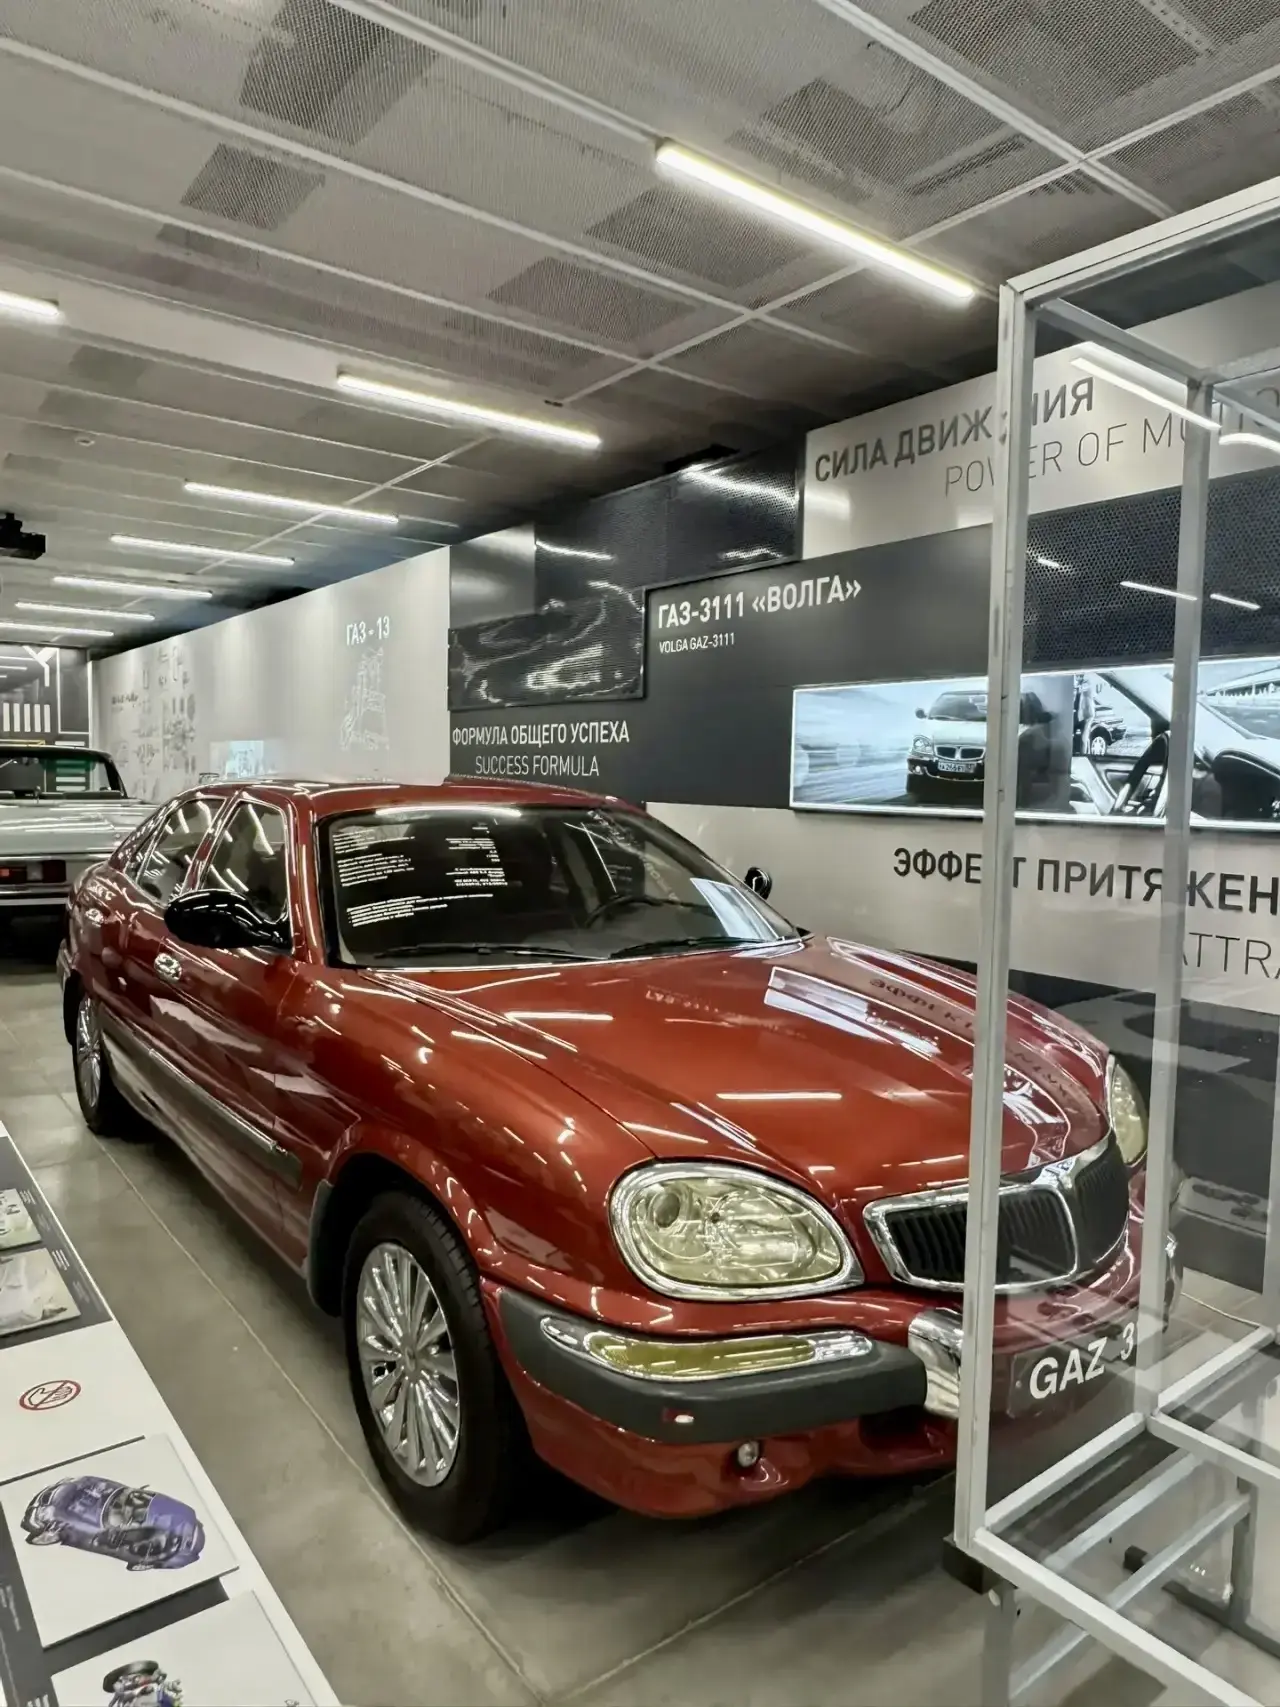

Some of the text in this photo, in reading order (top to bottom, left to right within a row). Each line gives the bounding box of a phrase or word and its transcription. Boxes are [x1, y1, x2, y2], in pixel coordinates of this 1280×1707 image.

[815, 438, 888, 482] СИЛА
[945, 441, 1062, 497] POER
[1078, 422, 1127, 467] OF
[658, 574, 862, 629] ГАЗ-3111 «ВОЛГА»
[346, 621, 366, 646] ГАЗ
[376, 615, 390, 640] 13
[659, 632, 735, 654] VOLGA GAZ-3111
[452, 720, 630, 749] ФОРМУЛА ОБЩЕГО УСПЕХА
[475, 755, 600, 776] SUCCESS FORMULA
[893, 847, 1027, 889] ЭФФЕТ
[1029, 1337, 1108, 1399] GAZ
